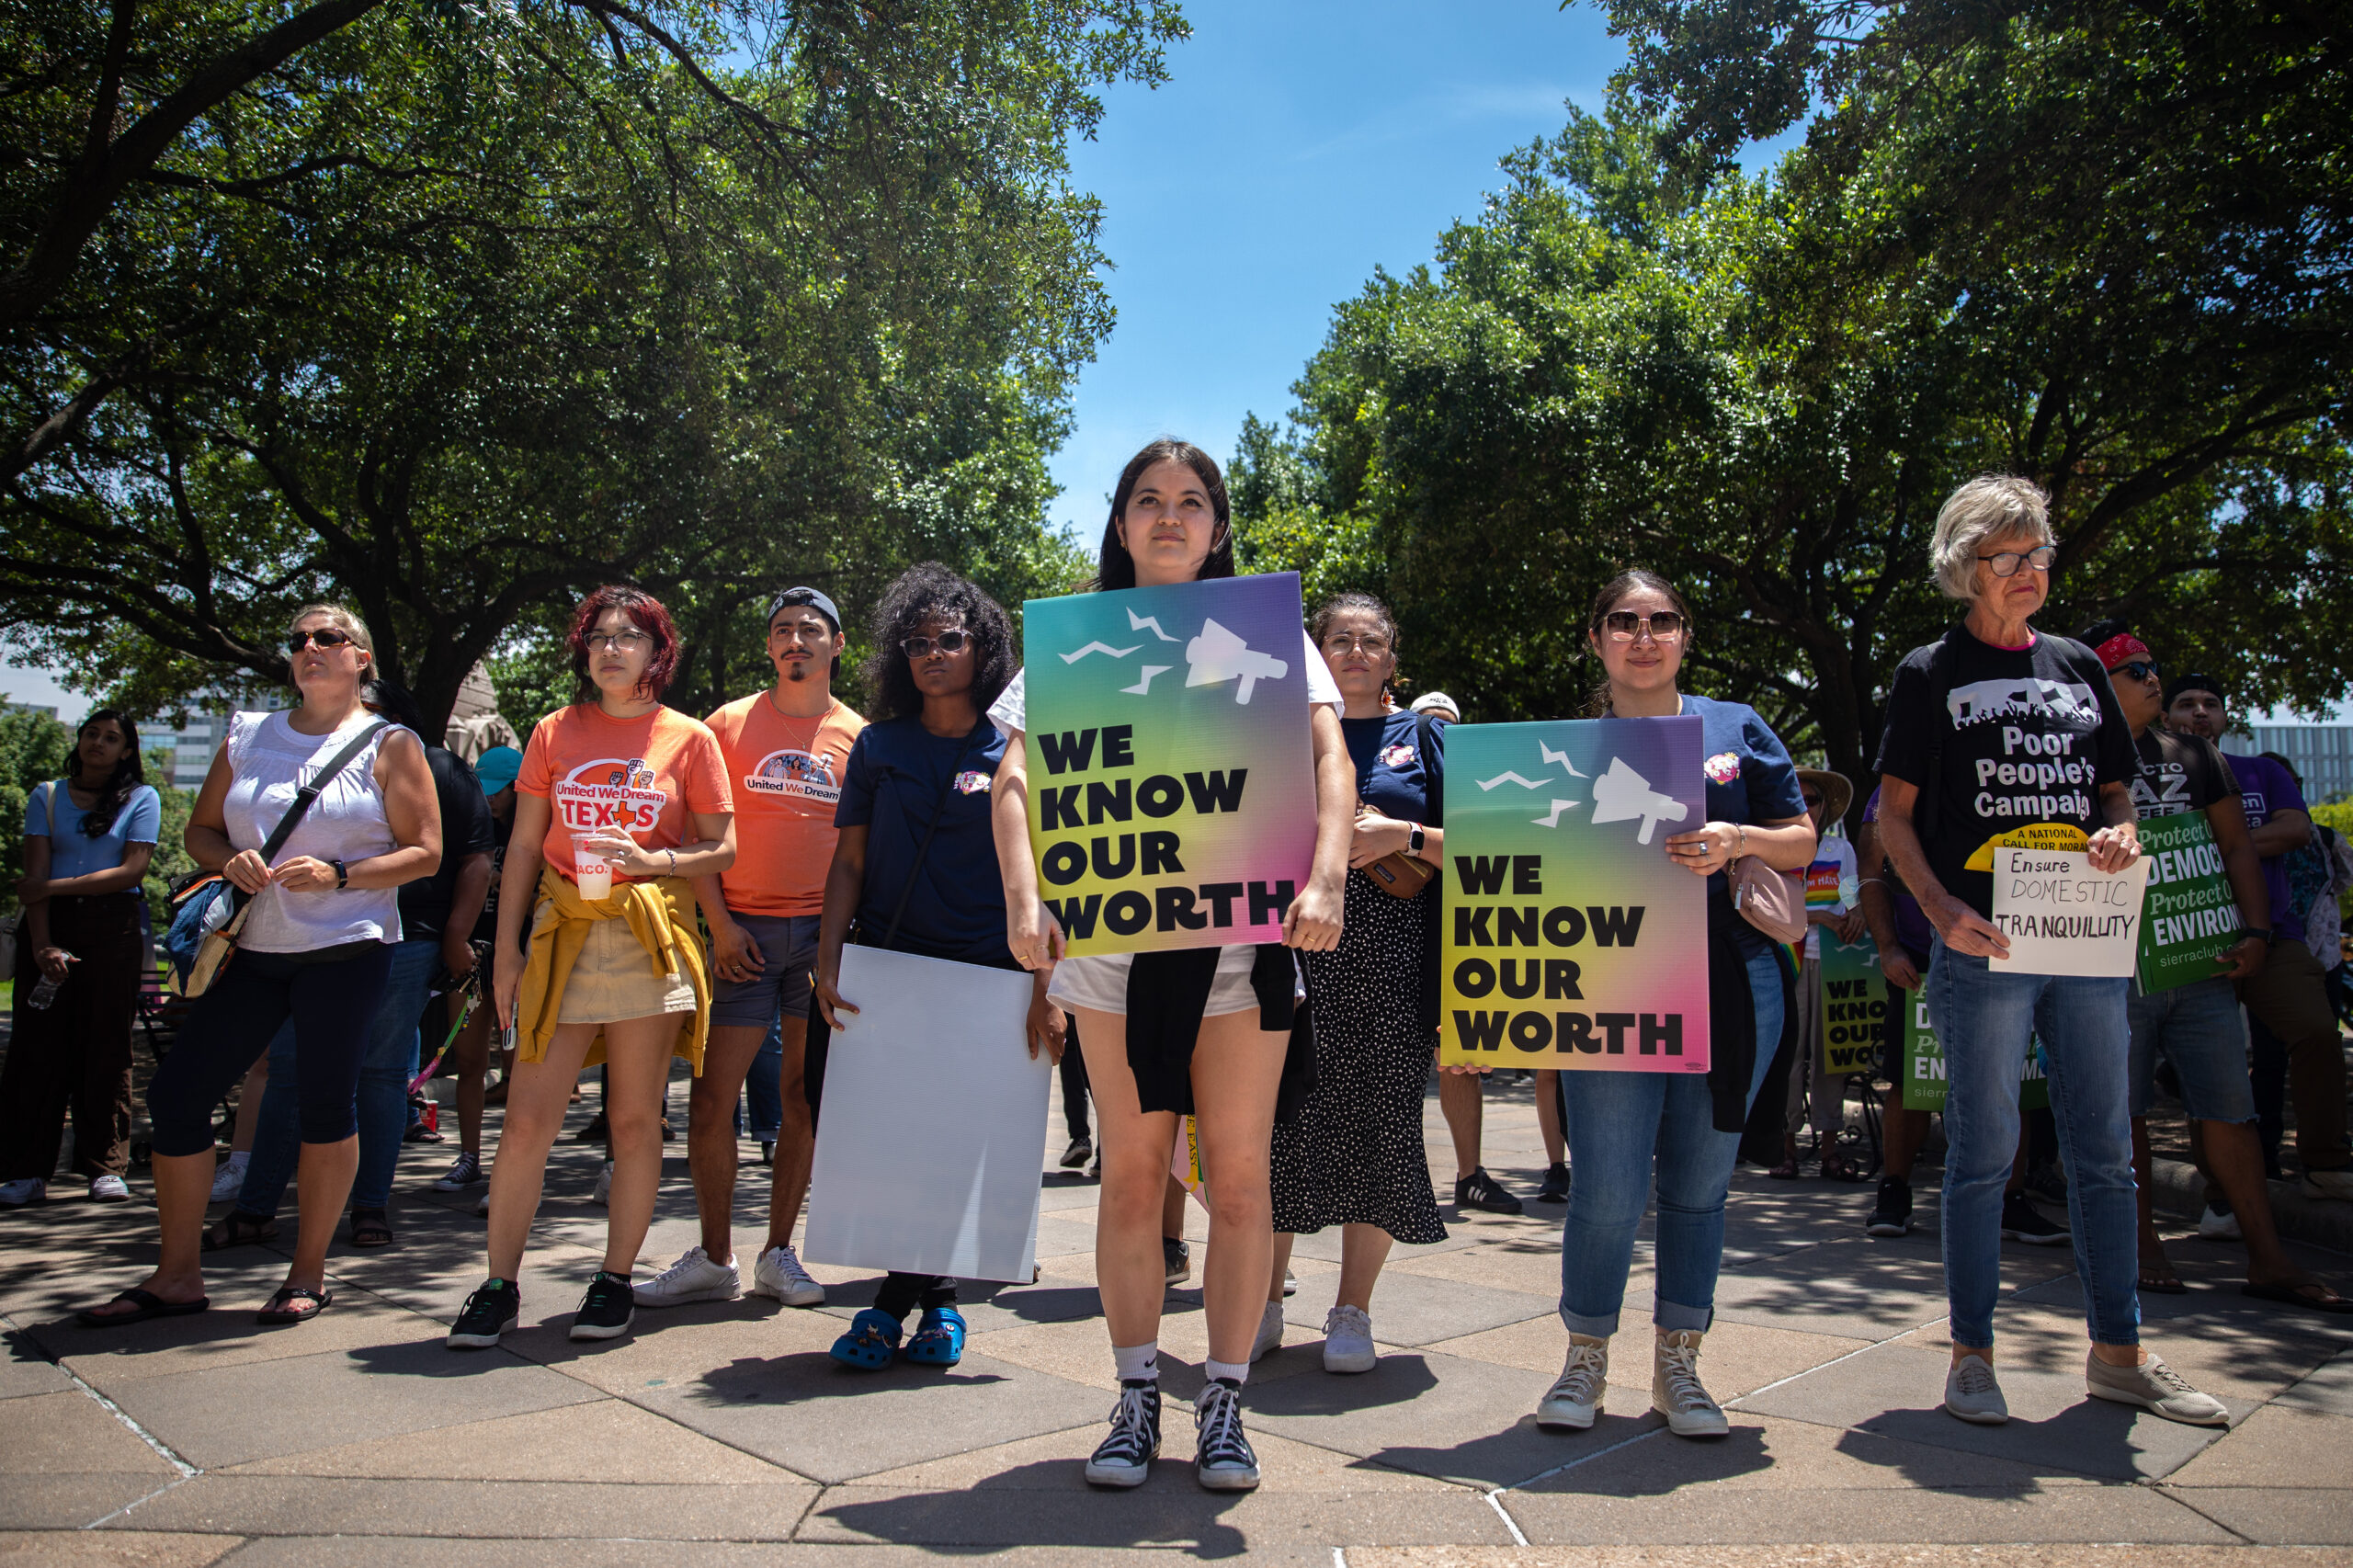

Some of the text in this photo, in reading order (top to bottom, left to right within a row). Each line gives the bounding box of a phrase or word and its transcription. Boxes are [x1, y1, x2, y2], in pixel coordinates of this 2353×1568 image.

[1038, 724, 1134, 775] WE
[2003, 726, 2074, 756] Poor
[747, 779, 839, 800] United We Dream
[1976, 757, 2095, 790] People's
[557, 783, 665, 802] United We Dream
[1040, 768, 1248, 832] KNOW
[2003, 839, 2029, 849] CALL
[2034, 842, 2055, 851] FOR
[2018, 829, 2077, 839] A NATIONAL
[2138, 824, 2205, 851] Protect
[1041, 830, 1186, 885] OUR
[2011, 852, 2070, 873] Ensure
[2146, 843, 2225, 886] DEMOC
[1453, 855, 1541, 895] WE
[2011, 879, 2128, 906] DOMESTIC
[2150, 882, 2223, 915] Protect
[1043, 880, 1296, 940] WORTH
[1454, 905, 1645, 948] KNOW
[1453, 958, 1585, 1000] OUR
[1826, 979, 1868, 999] WE
[1452, 1009, 1683, 1056] WORTH
[1187, 1132, 1198, 1167] EASY
